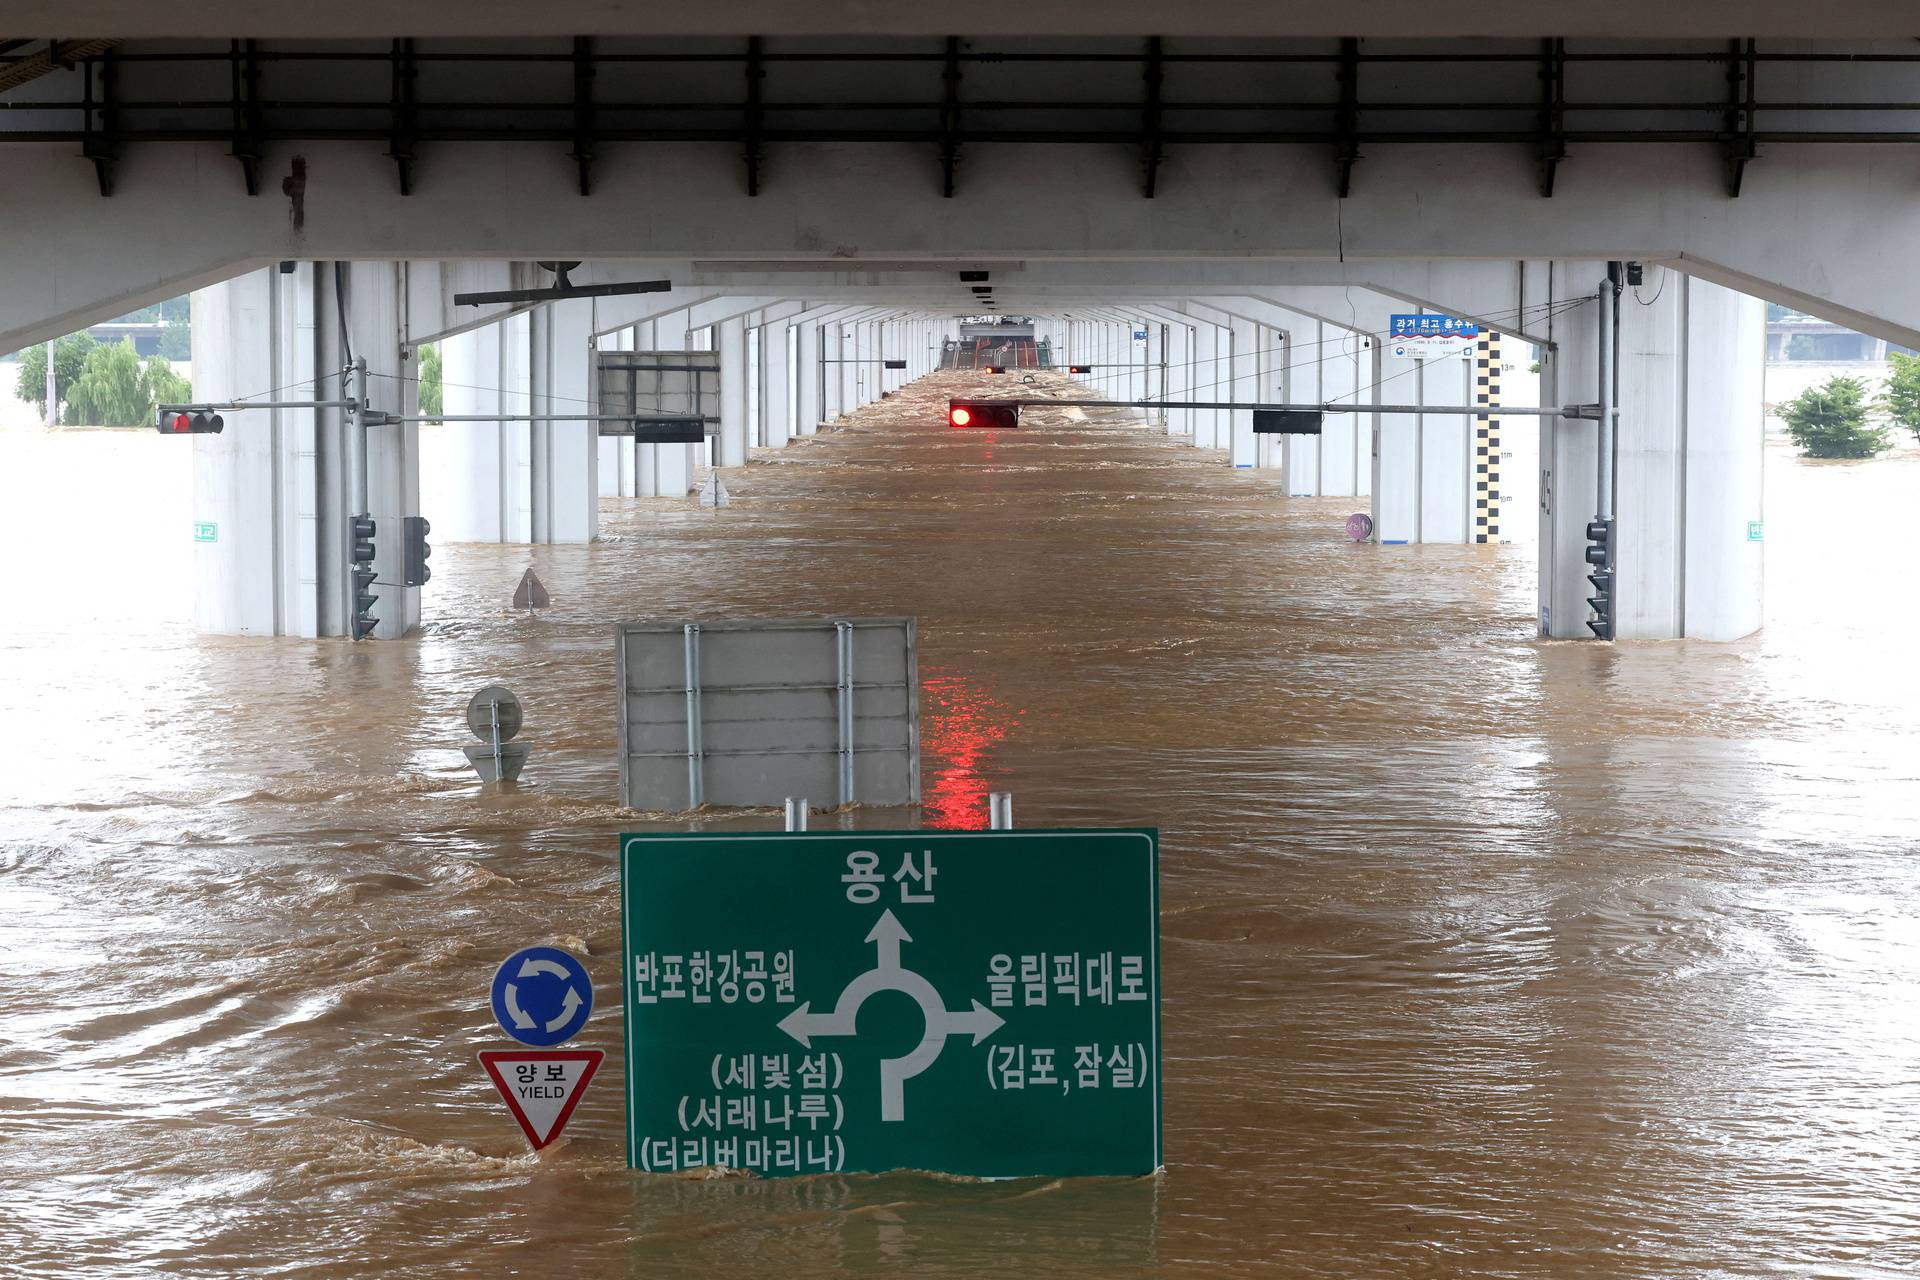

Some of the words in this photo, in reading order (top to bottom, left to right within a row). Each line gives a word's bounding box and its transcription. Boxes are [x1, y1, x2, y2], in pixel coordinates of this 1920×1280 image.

[1396, 318, 1416, 329] 과거
[1420, 318, 1440, 329] 최고
[841, 850, 938, 904] 용산
[635, 949, 796, 1004] 반포한강공원
[986, 951, 1148, 1008] 올림픽대로
[711, 1053, 843, 1089] (세빛섬)
[518, 1086, 565, 1099] YIELD
[678, 1095, 844, 1132] (서래나루)
[640, 1135, 845, 1172] (더리버마리나)
